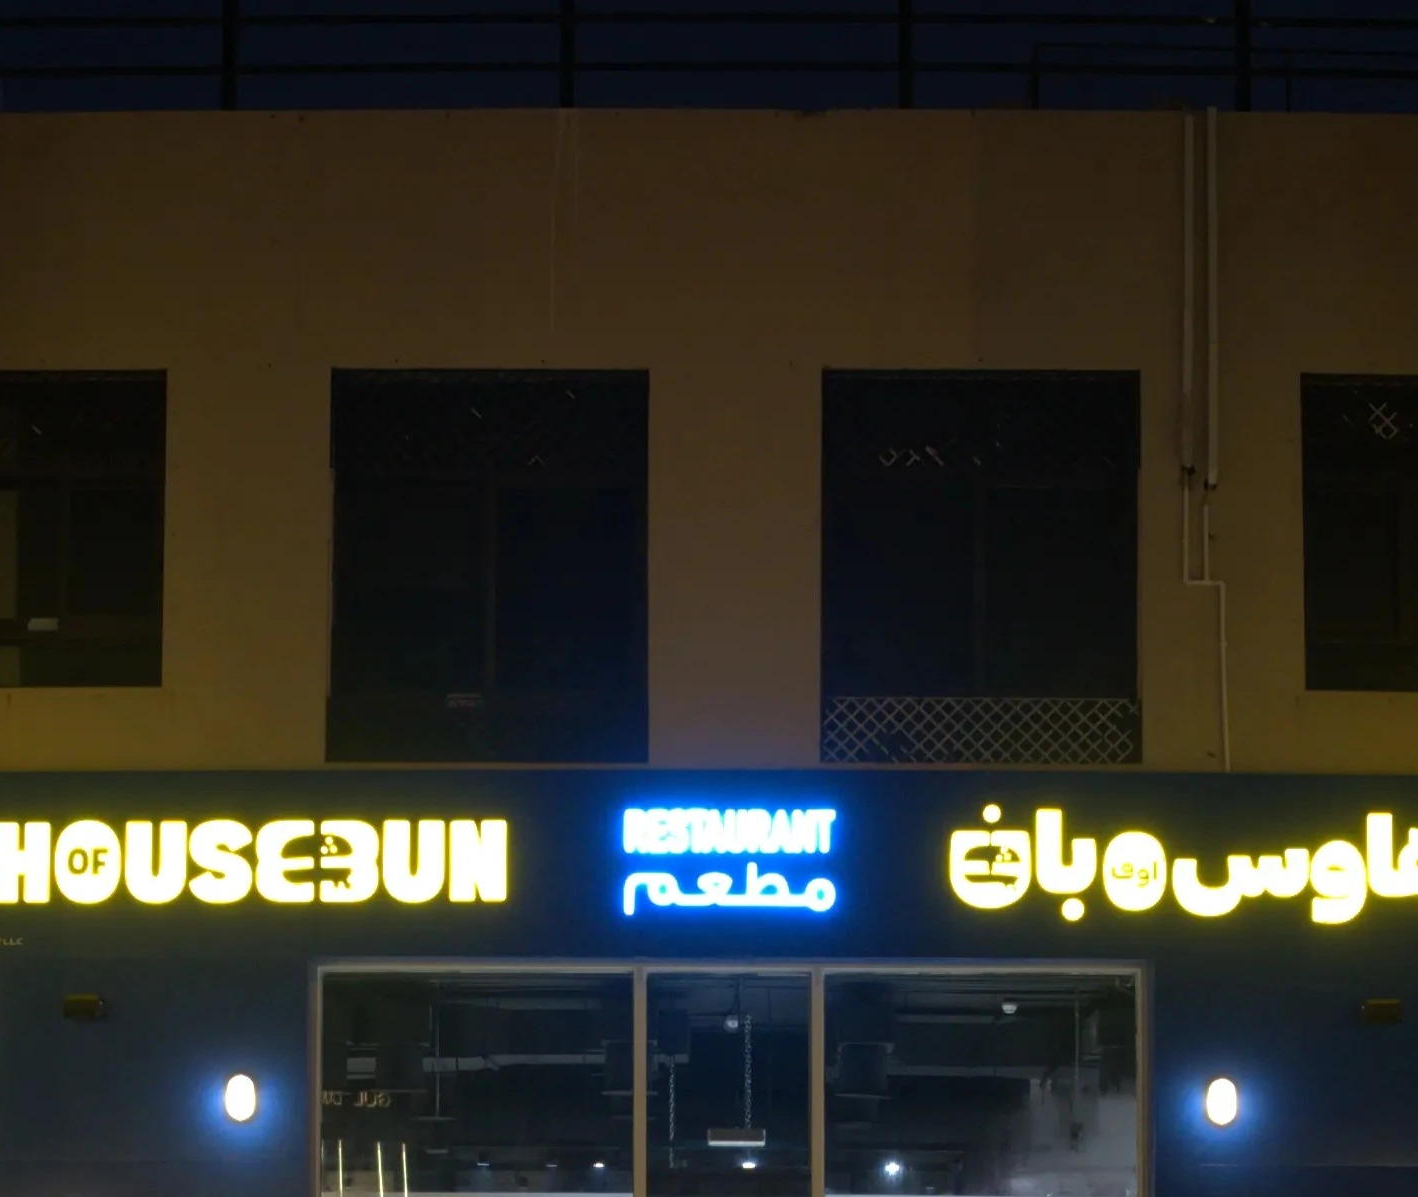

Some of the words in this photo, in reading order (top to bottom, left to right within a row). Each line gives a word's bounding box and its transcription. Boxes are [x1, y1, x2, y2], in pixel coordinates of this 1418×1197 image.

[622, 807, 837, 854] RESTAURANT
[66, 847, 109, 875] OF
[318, 819, 509, 904] BUN
[622, 861, 837, 916] مطعم
